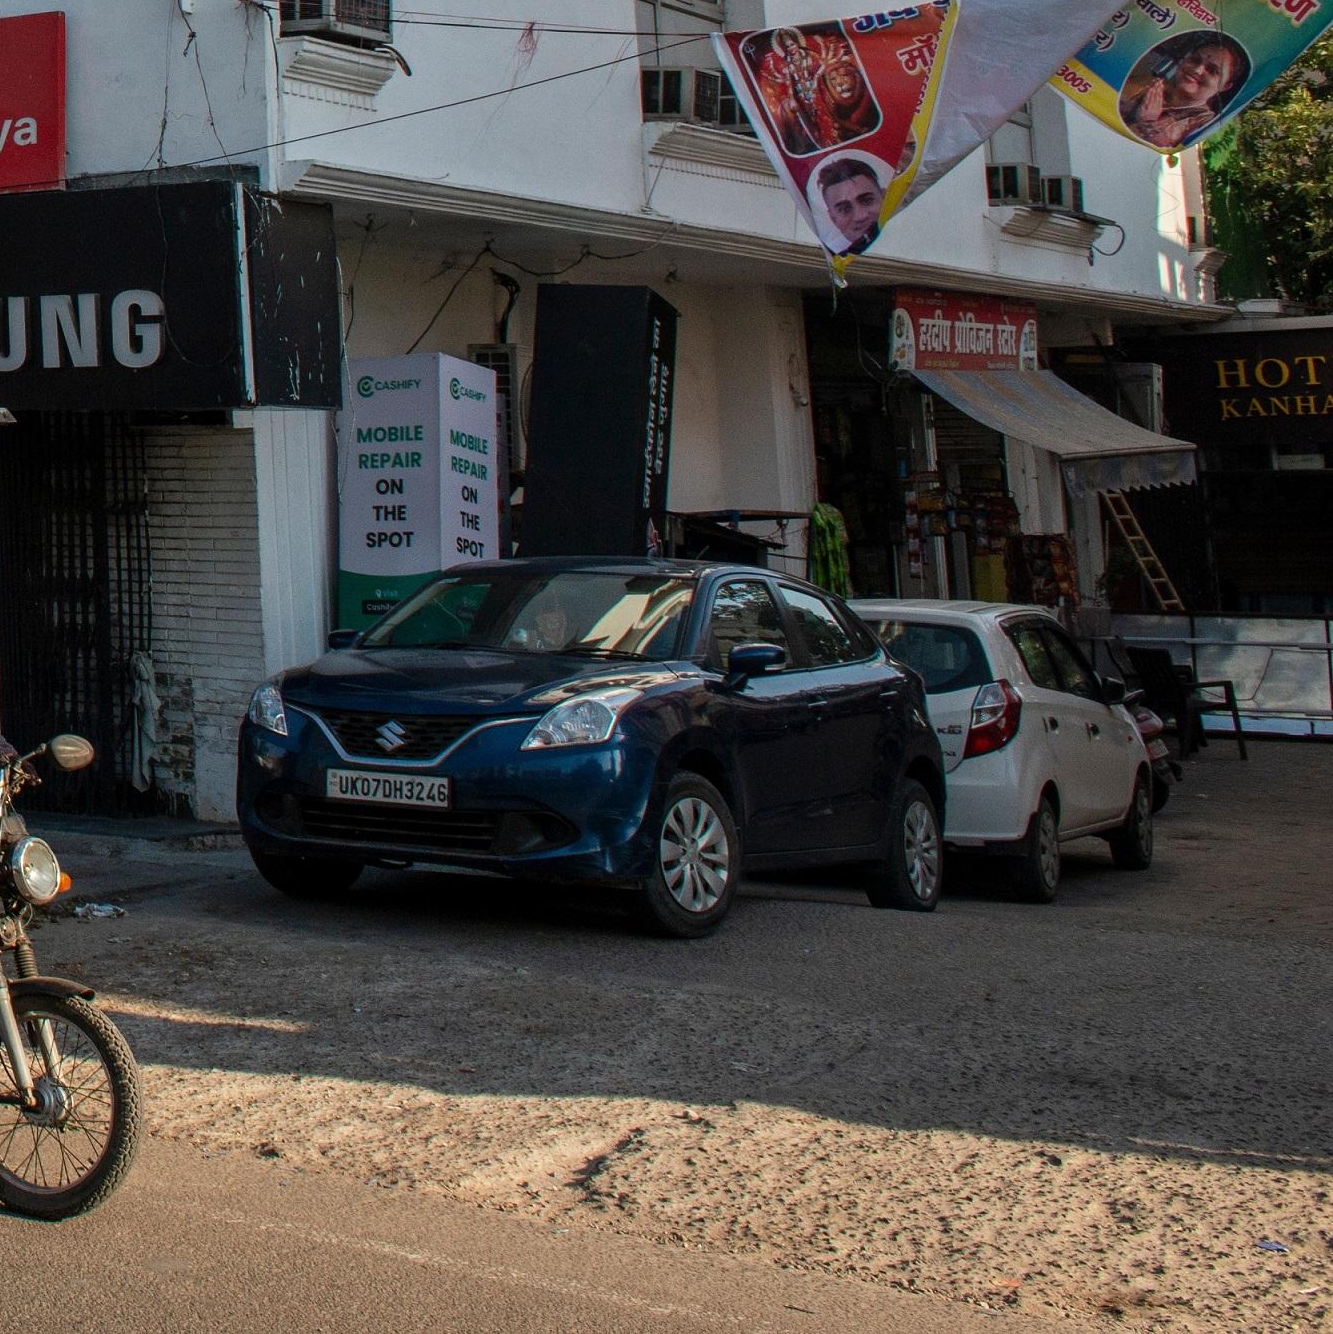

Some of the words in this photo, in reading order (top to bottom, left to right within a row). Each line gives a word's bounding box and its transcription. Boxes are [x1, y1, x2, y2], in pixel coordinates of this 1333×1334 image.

[995, 314, 1018, 356] स्टोर
[374, 378, 422, 391] CASHIFY
[459, 387, 487, 403] CASHIFY
[356, 424, 424, 444] MOBILE
[449, 428, 489, 456] MOBILE
[358, 451, 422, 470] REPAIR
[450, 455, 488, 482] REPAIR
[375, 478, 404, 495] ON
[461, 485, 478, 505] ON
[373, 504, 407, 522] THE
[459, 510, 481, 532] THE
[366, 531, 414, 549] SPOT
[456, 536, 484, 559] SPOT
[338, 775, 448, 803] UK07DH3246
